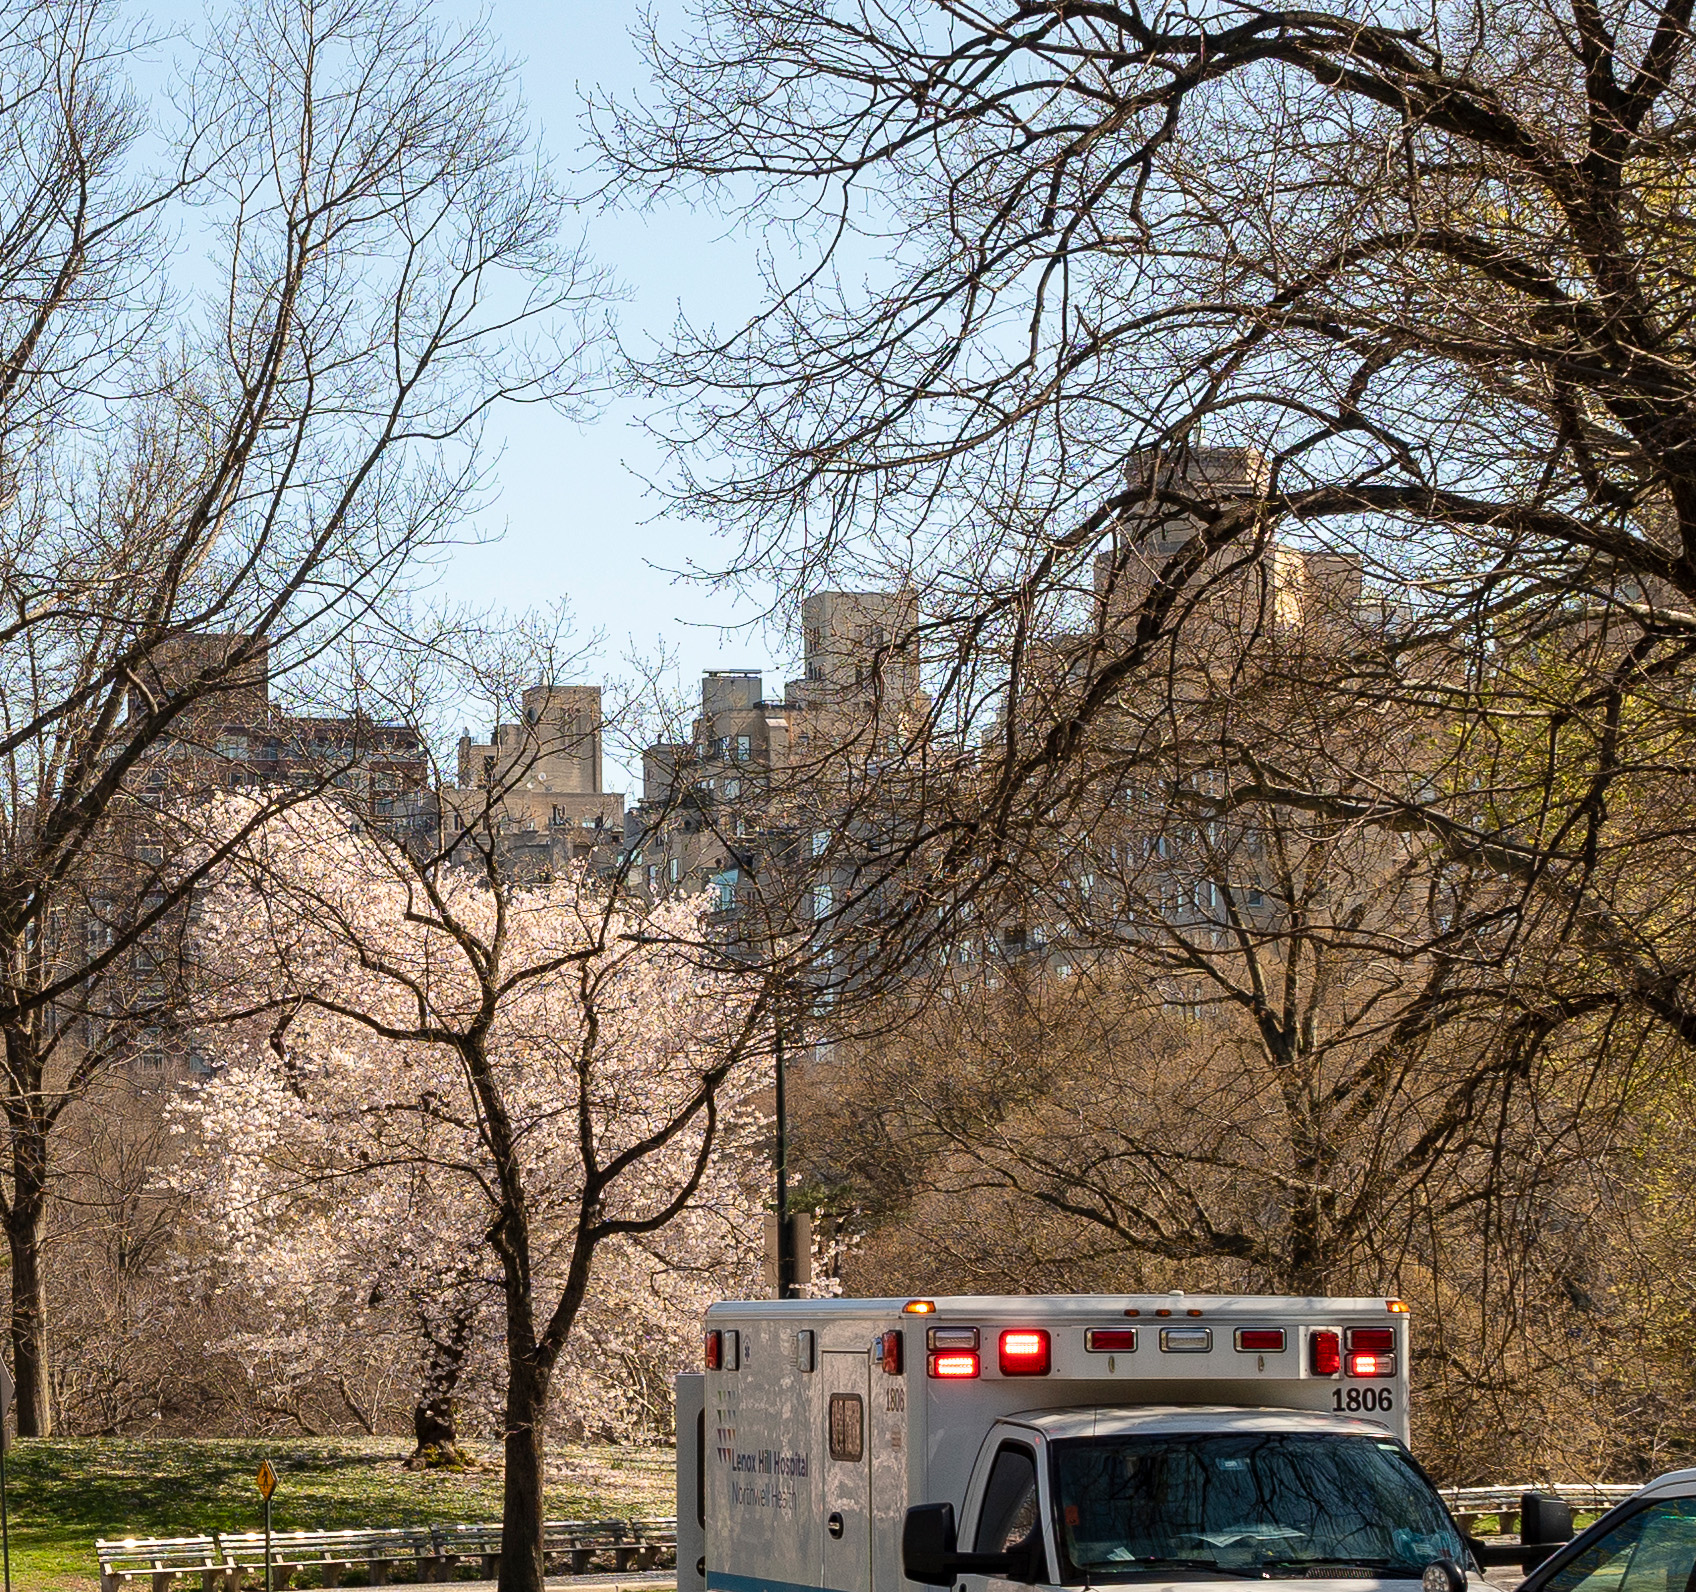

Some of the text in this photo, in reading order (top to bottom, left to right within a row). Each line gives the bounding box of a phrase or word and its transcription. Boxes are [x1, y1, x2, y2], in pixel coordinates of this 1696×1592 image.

[1332, 1387, 1393, 1412] 1806
[732, 1449, 809, 1479] Lenox Hill Hospital
[732, 1481, 770, 1507] Northwell
